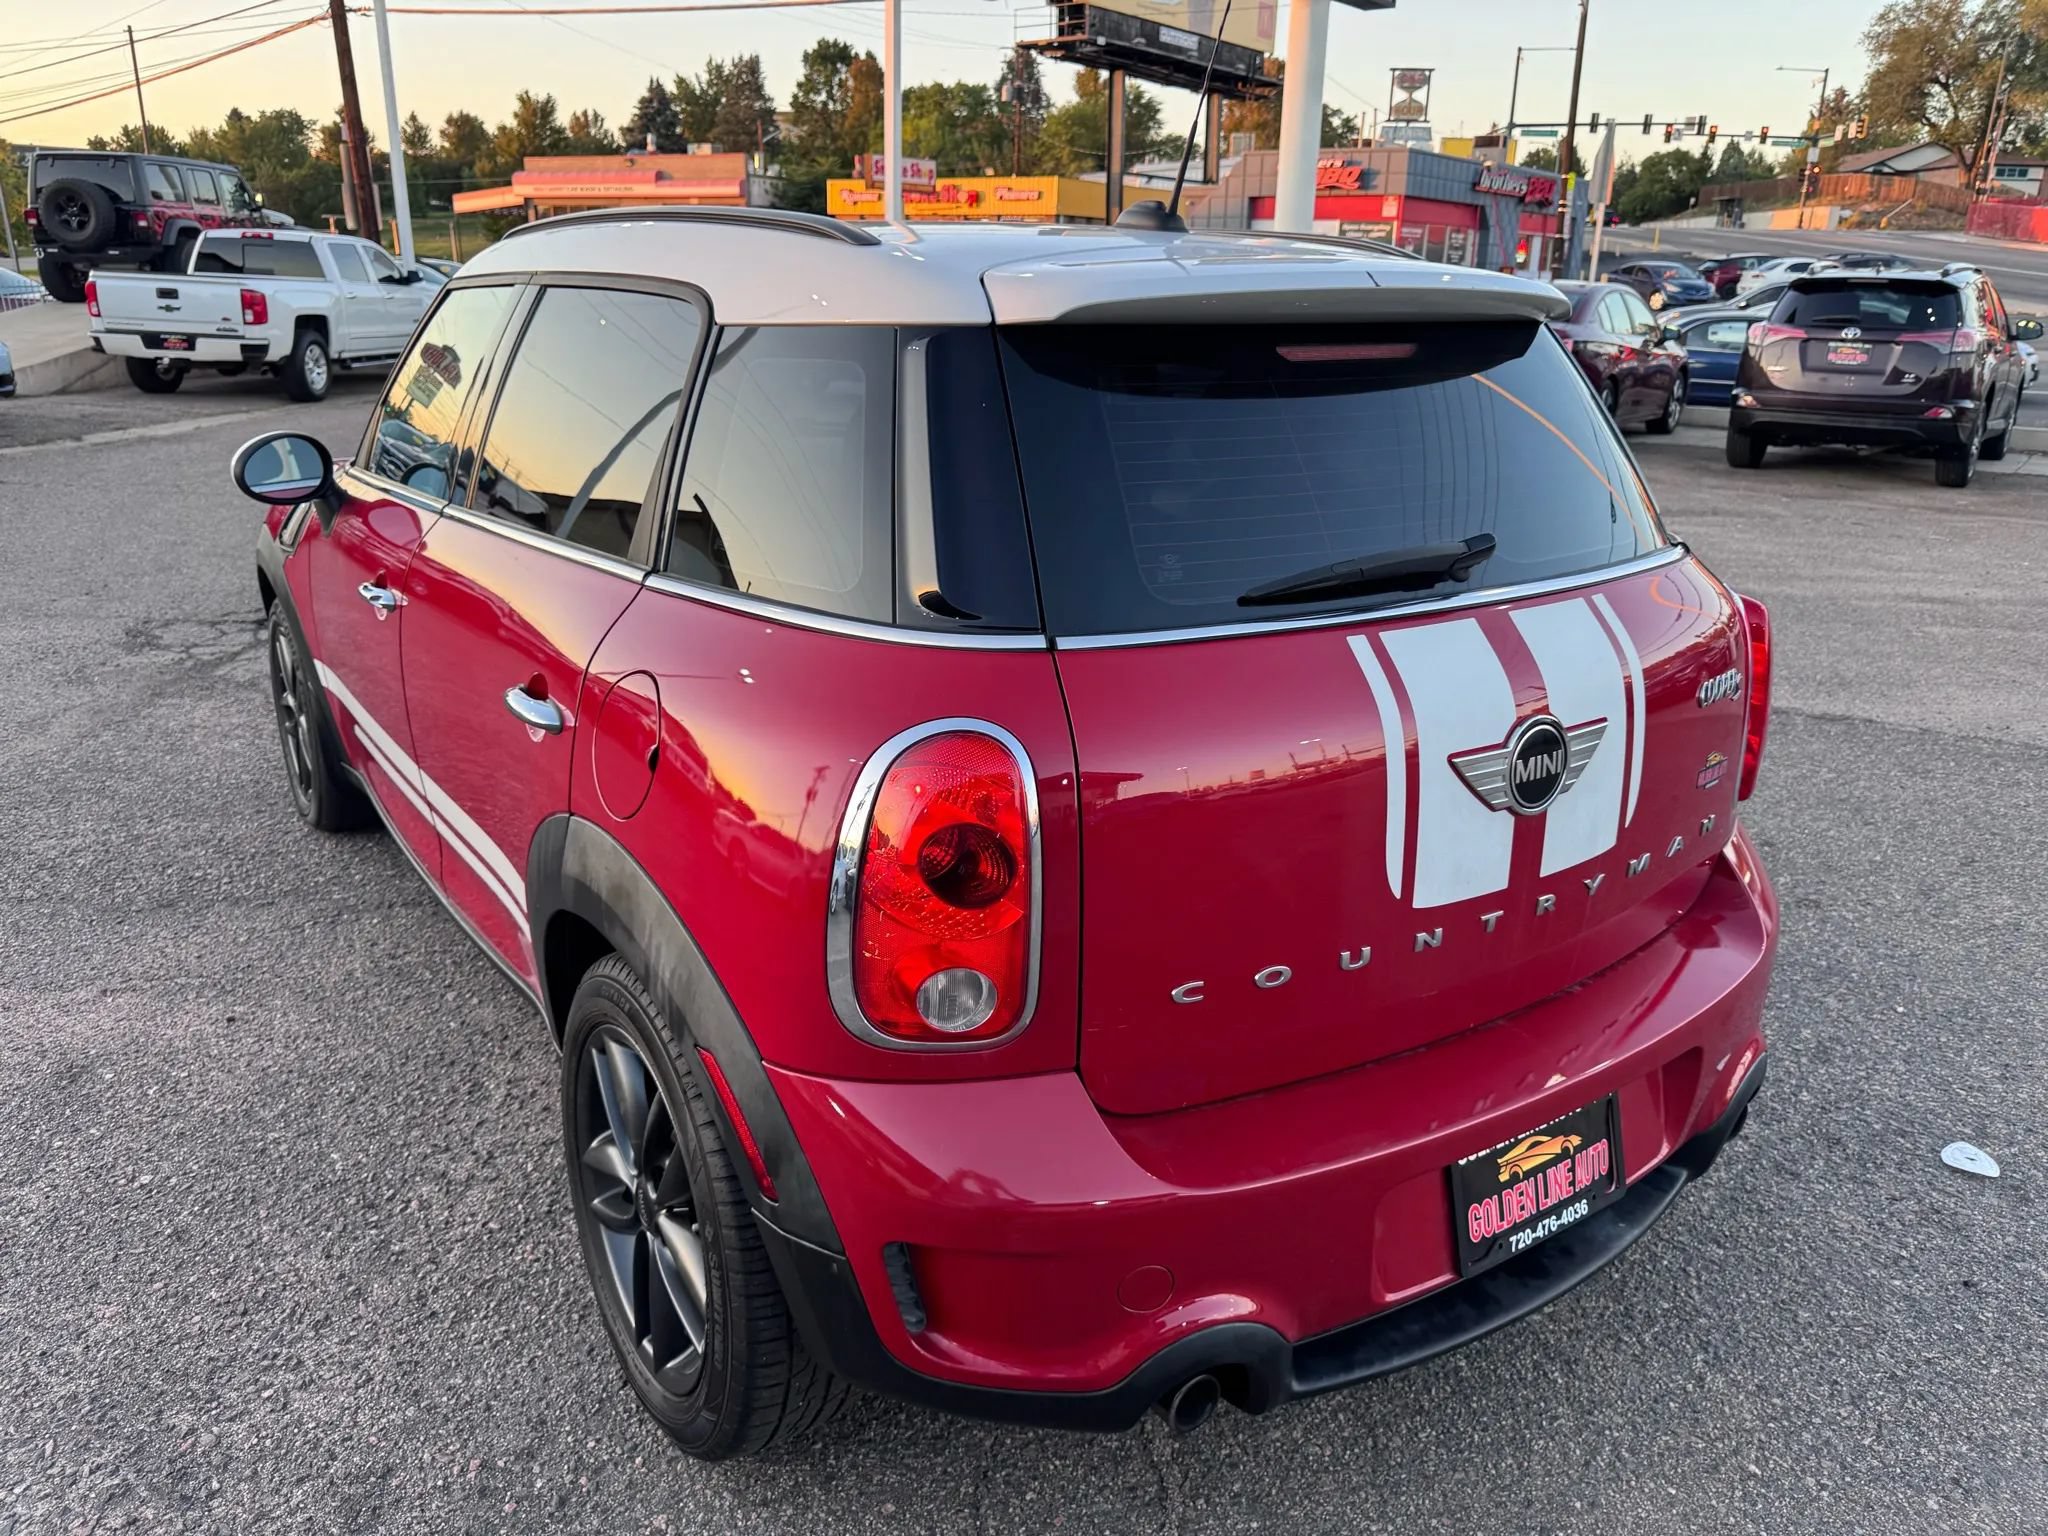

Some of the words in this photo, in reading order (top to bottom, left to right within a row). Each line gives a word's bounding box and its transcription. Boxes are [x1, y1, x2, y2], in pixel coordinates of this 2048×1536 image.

[1515, 749, 1562, 784] MINI
[1171, 814, 1716, 1004] COUNTRYMAN
[1467, 1176, 1536, 1243] GOLDEN
[1537, 1158, 1574, 1210] LINE
[1575, 1138, 1609, 1192] AUTO
[1508, 1199, 1589, 1253] 720-476-4036
